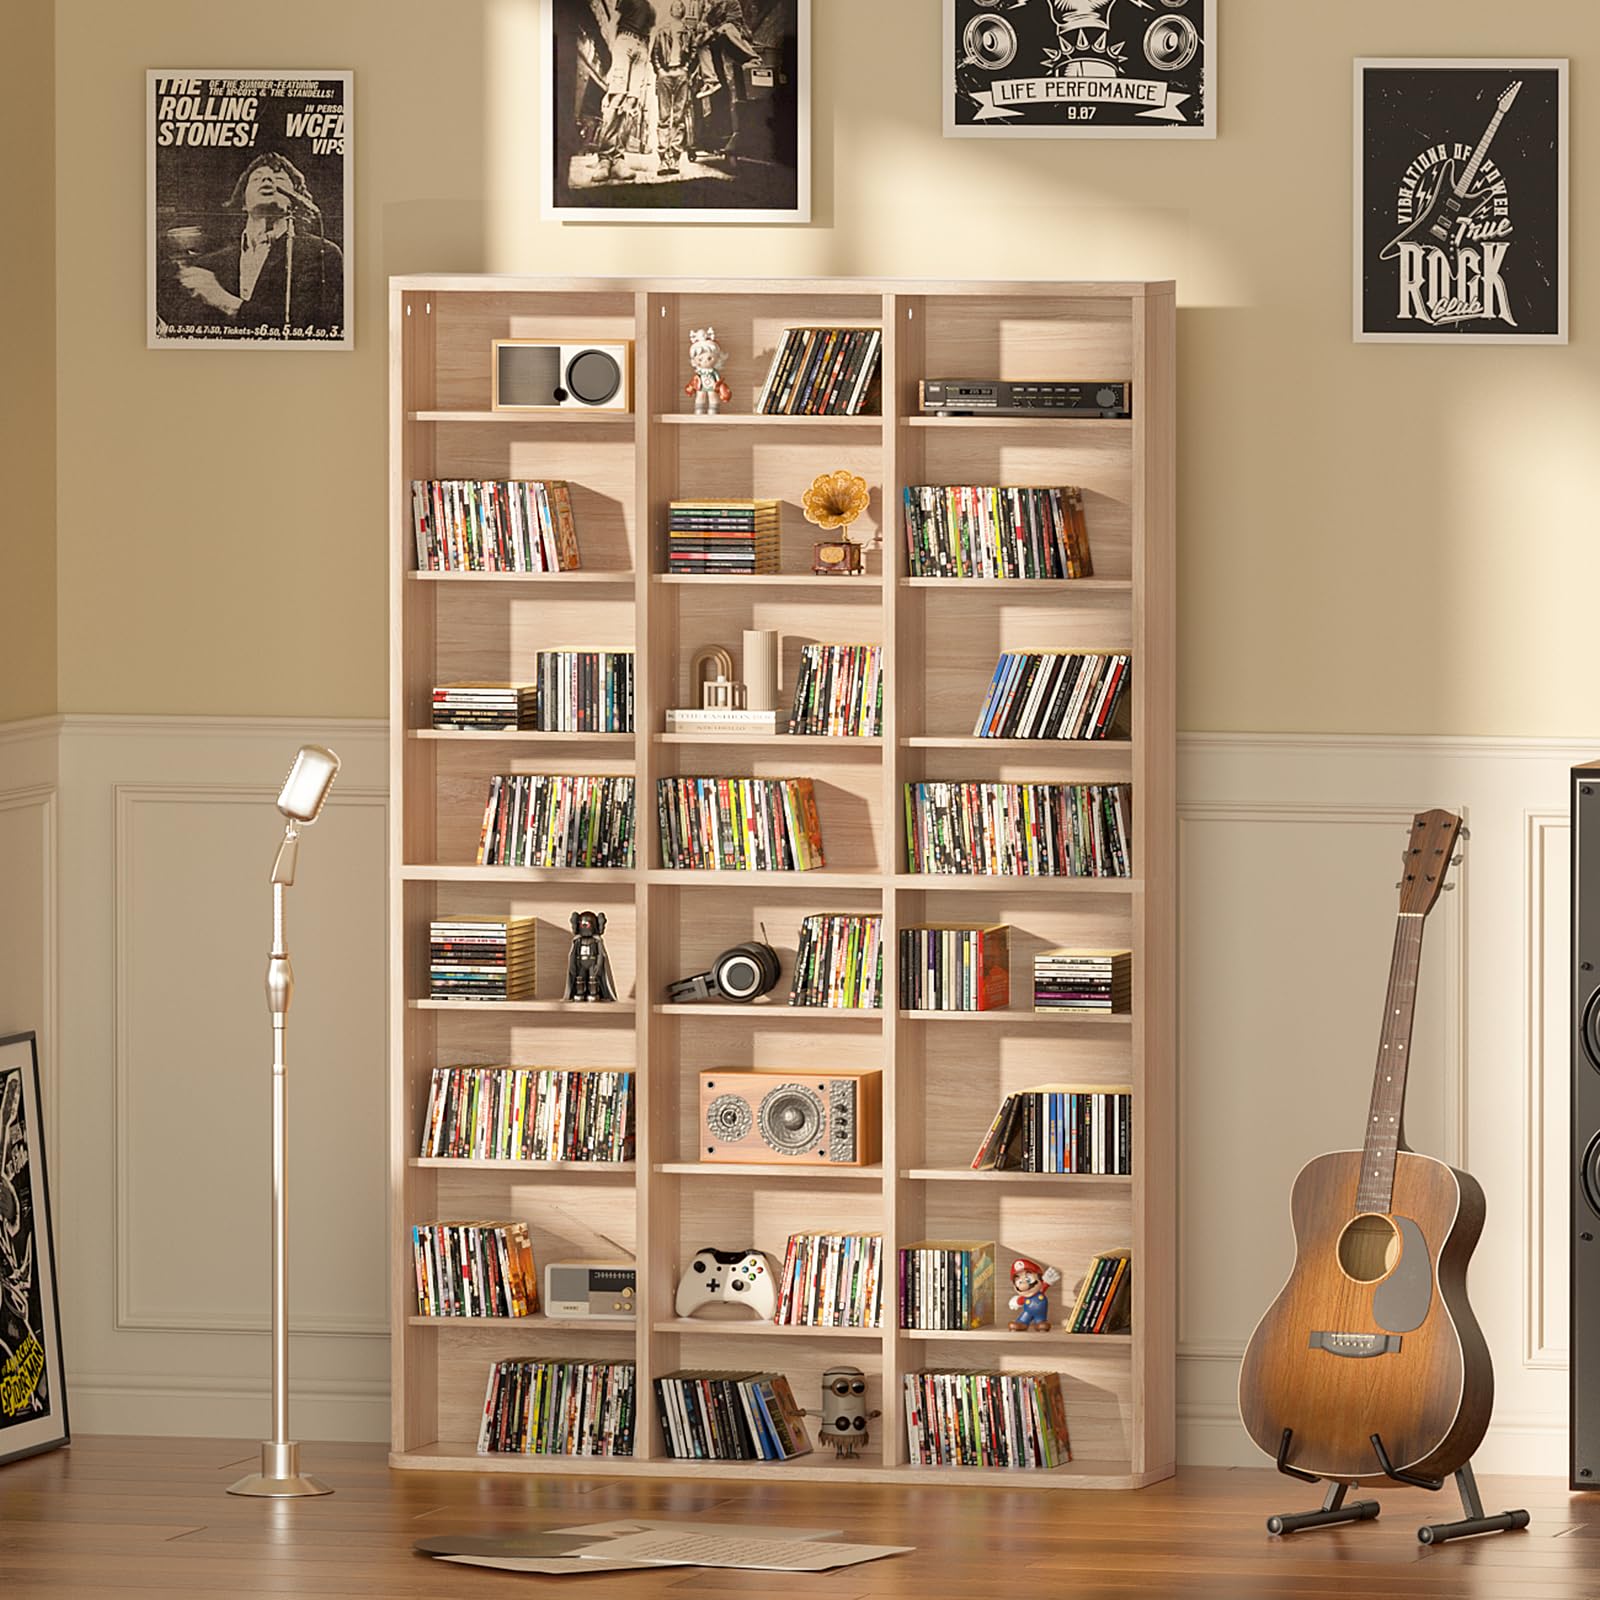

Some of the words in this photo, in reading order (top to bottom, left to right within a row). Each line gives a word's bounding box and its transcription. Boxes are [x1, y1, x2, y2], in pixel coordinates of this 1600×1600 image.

[158, 79, 202, 95] THE
[270, 89, 285, 97] THE
[287, 89, 335, 98] STANDELLS!
[1001, 83, 1036, 100] LIFE
[1045, 82, 1157, 100] PERFOMANCE
[158, 96, 259, 121] ROLLING
[304, 104, 314, 113] IN
[1067, 106, 1097, 120] 9.07
[157, 122, 259, 147] STONES!
[1397, 143, 1448, 225] VIBRATIONS
[1453, 143, 1473, 161] OF
[1480, 159, 1509, 217] POWER
[1454, 216, 1514, 248] True
[1396, 241, 1518, 327] ROCK
